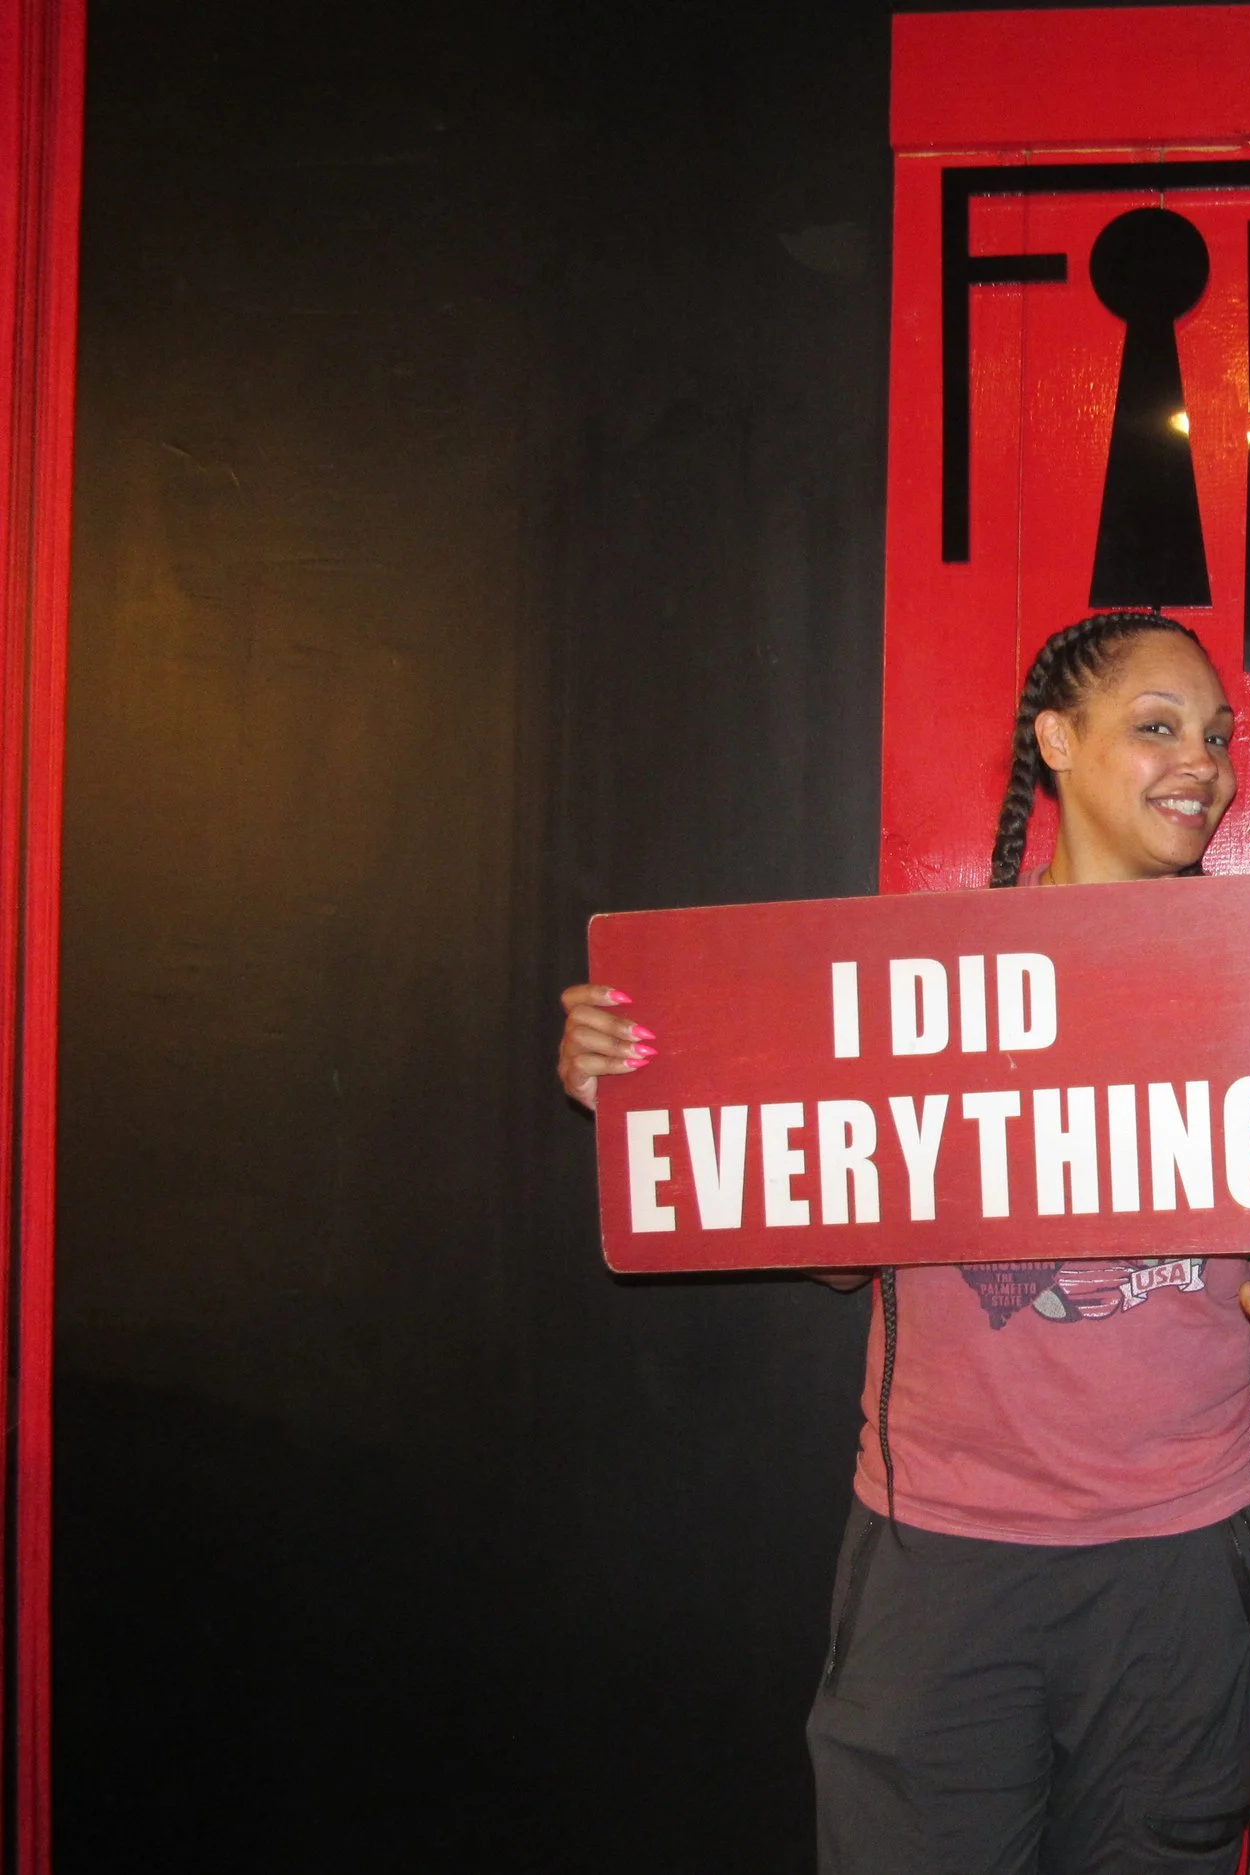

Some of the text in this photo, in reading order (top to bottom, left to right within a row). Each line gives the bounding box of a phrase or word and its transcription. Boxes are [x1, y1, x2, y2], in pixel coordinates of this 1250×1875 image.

[832, 952, 1058, 1058] I DID
[1135, 1262, 1188, 1291] USA
[980, 1282, 1037, 1295] PALMETTO
[991, 1295, 1023, 1307] STATE
